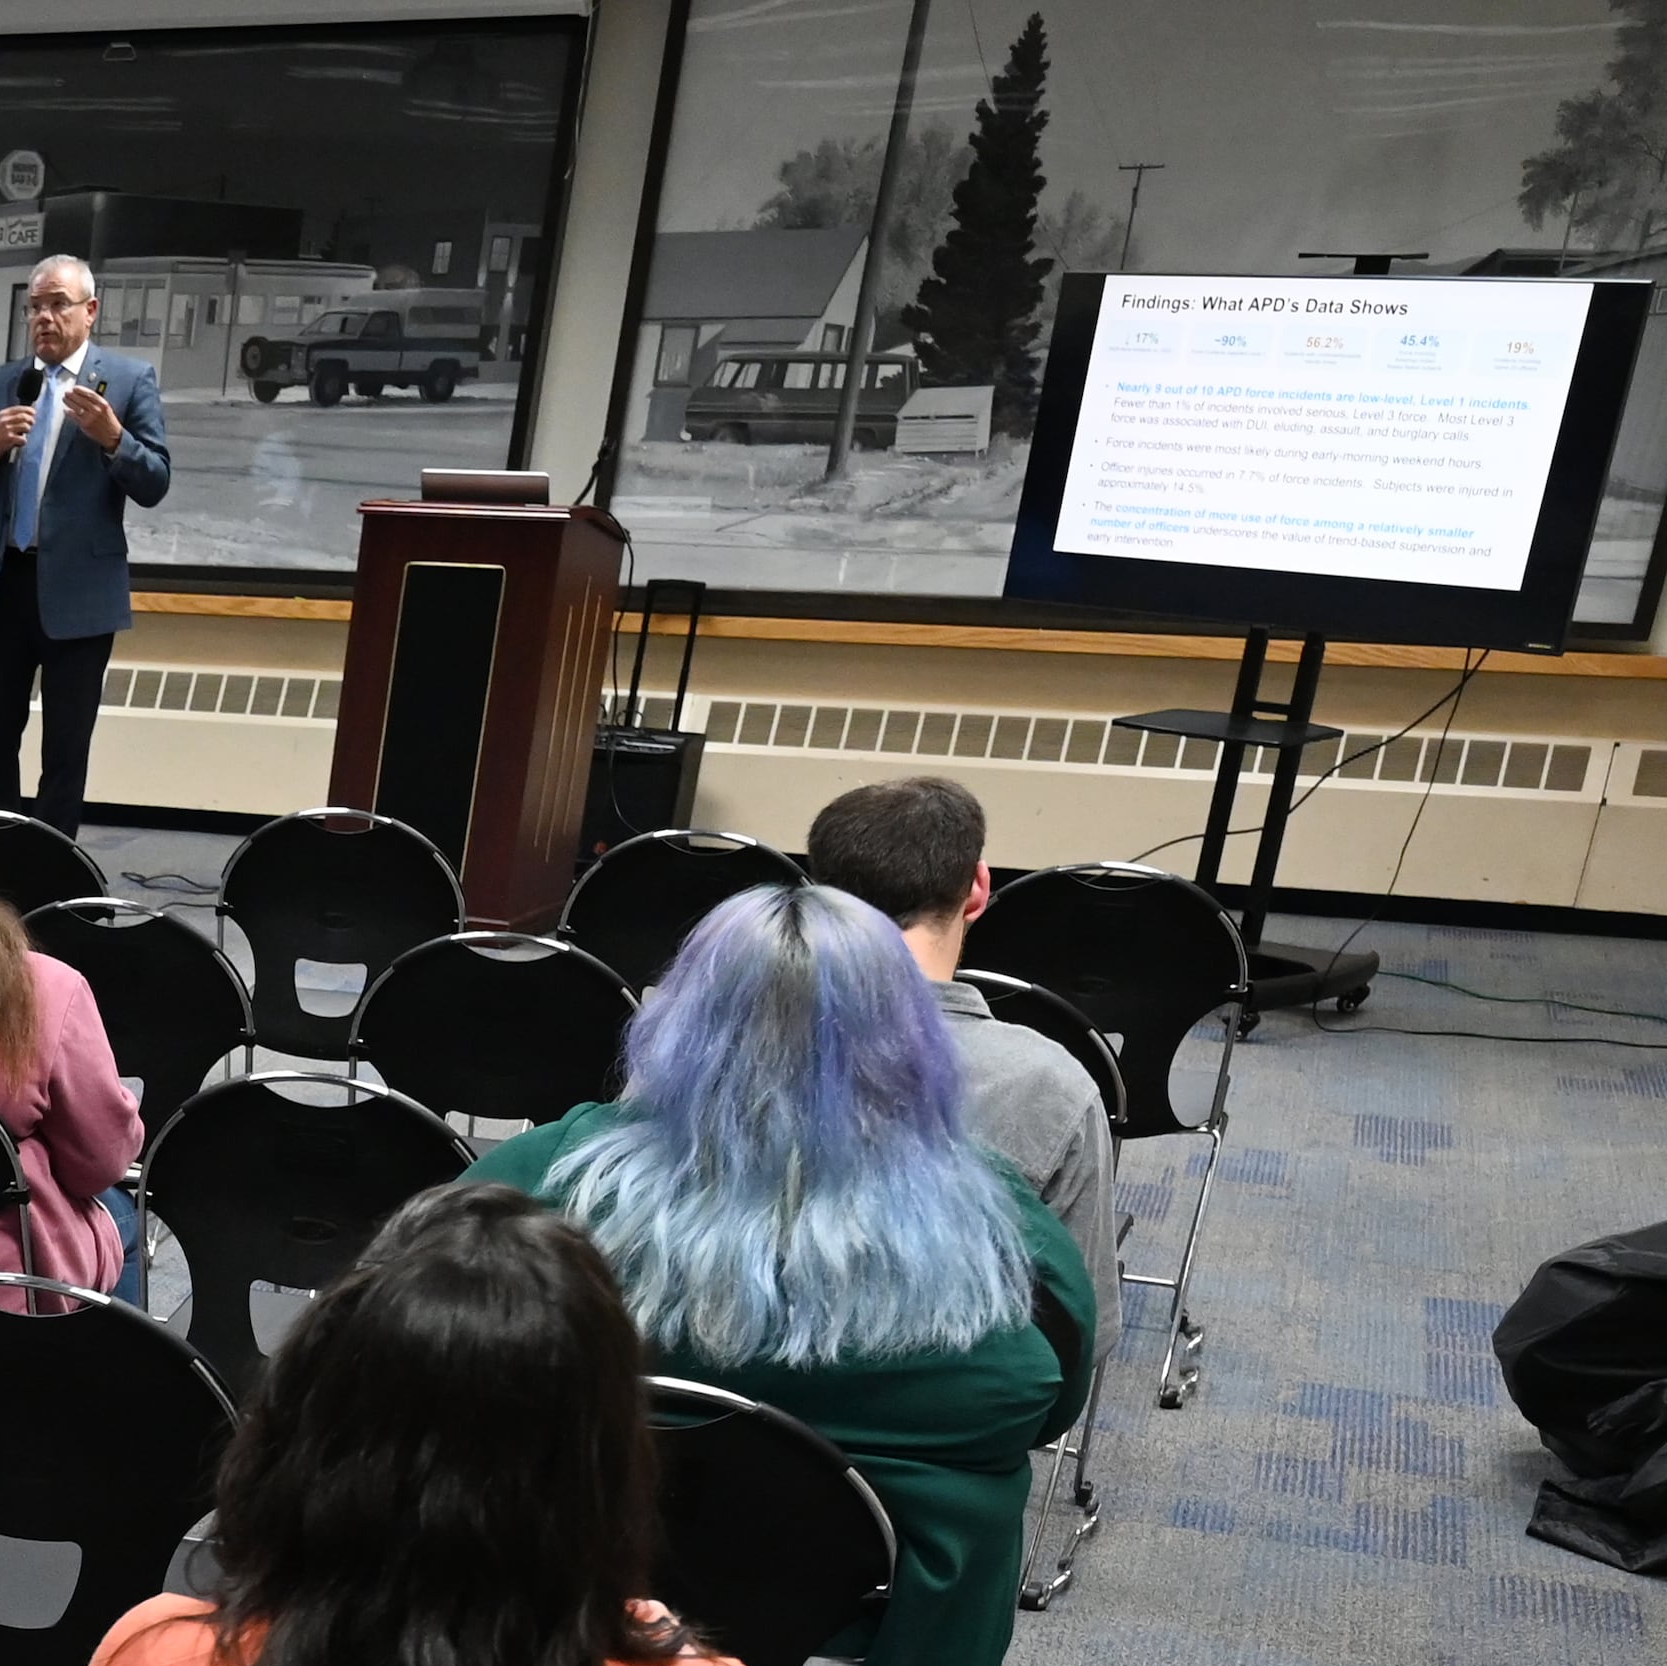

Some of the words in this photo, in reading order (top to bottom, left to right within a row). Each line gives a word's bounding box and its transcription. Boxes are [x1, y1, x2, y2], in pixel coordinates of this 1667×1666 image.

[1121, 294, 1196, 313] Findings:
[1202, 296, 1243, 311] What
[1248, 297, 1299, 313] APD's
[1305, 298, 1344, 315] Data
[1349, 299, 1408, 316] Shows
[1137, 332, 1159, 345] 17%
[1306, 337, 1344, 350] 56.2%
[1400, 334, 1440, 348] 45.4%
[1507, 341, 1534, 354] 19%
[1117, 382, 1151, 394] Nearly
[1165, 384, 1183, 394] out
[1187, 384, 1199, 395] of
[1202, 385, 1213, 395] 10
[1217, 386, 1241, 396] APD
[1246, 387, 1275, 399] force
[1278, 388, 1332, 400] incidents
[1336, 393, 1355, 403] are
[1421, 395, 1454, 406] Level
[1114, 397, 1145, 409] Fewer
[1149, 398, 1171, 409] than
[1177, 400, 1191, 411] 1%
[1194, 400, 1205, 411] of
[1207, 402, 1254, 414] incidents
[1258, 404, 1302, 416] involved
[1353, 409, 1384, 420] Level
[1387, 410, 1394, 420] 3
[1438, 412, 1467, 424] Most
[1471, 414, 1503, 426] Level
[1507, 416, 1514, 426] 3
[1111, 412, 1136, 424] force
[1139, 415, 1160, 424] was
[1162, 415, 1219, 428] associated
[1222, 419, 1243, 430] with
[1367, 426, 1389, 437] and
[1392, 427, 1438, 441] burglary
[1106, 437, 1134, 449] Force
[1138, 439, 1183, 452] incidents
[1187, 443, 1211, 453] were
[1214, 443, 1241, 454] most
[1244, 444, 1269, 457] likely
[1274, 446, 1308, 460] during
[1312, 449, 1388, 466] early-morning
[1393, 455, 1444, 467] weekend
[1448, 456, 1483, 470] hours.
[1097, 477, 1168, 492] approximately
[1101, 461, 1134, 472] Officer
[1177, 467, 1222, 479] occurred
[1226, 469, 1235, 480] in
[1269, 471, 1280, 483] of
[1283, 472, 1310, 484] force
[1373, 478, 1422, 493] Subjects
[1427, 484, 1455, 495] were
[1459, 484, 1499, 498] injured
[1503, 486, 1513, 498] in
[1094, 500, 1112, 512] The
[1116, 504, 1191, 518] concentration
[1194, 508, 1205, 519] of
[1209, 511, 1237, 520] more
[1241, 513, 1262, 522] use
[1265, 513, 1276, 524] of
[1280, 514, 1309, 526] force
[1313, 519, 1354, 532] among
[1368, 521, 1423, 536] relatively
[1427, 526, 1475, 539] smaller
[1087, 531, 1110, 544] early
[1090, 518, 1131, 529] number
[1135, 519, 1145, 530] of
[1149, 520, 1189, 534] officers
[1193, 525, 1257, 539] underscores
[1261, 529, 1278, 540] the
[1282, 530, 1311, 543] value
[1314, 533, 1326, 545] of
[1329, 535, 1395, 550] trend-based
[1400, 540, 1465, 555] supervision
[1469, 546, 1491, 557] and
